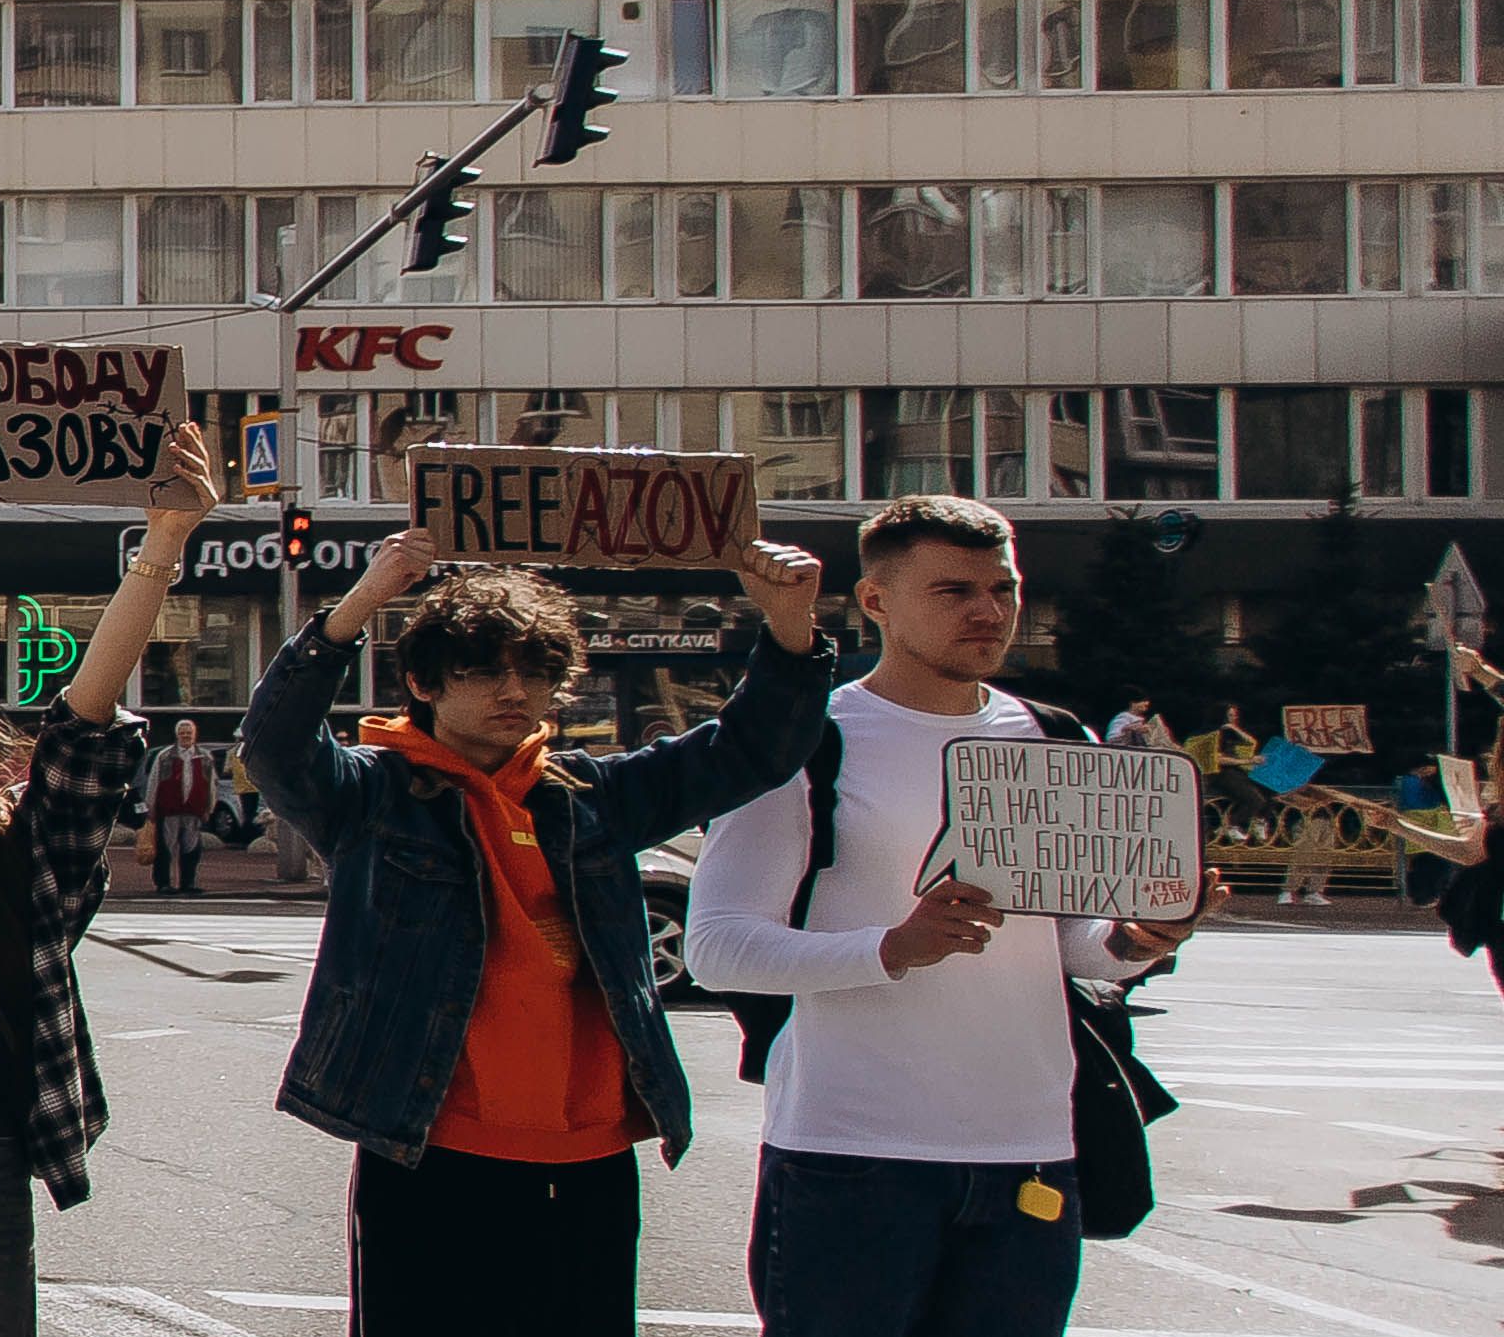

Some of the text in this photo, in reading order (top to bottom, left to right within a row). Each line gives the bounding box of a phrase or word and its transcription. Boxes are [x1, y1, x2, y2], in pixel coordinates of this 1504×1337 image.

[296, 325, 454, 371] KFC
[627, 634, 716, 648] CITYKAVA
[955, 746, 1180, 793] ВОНИ БОРОЛИСЬ
[960, 786, 994, 822] ЗА
[1078, 792, 1163, 832] ТЕПЕР
[962, 827, 1181, 879] ЧАС БОРОТИСЬ
[1011, 871, 1044, 910] ЗА
[1148, 890, 1191, 908] AZOV
